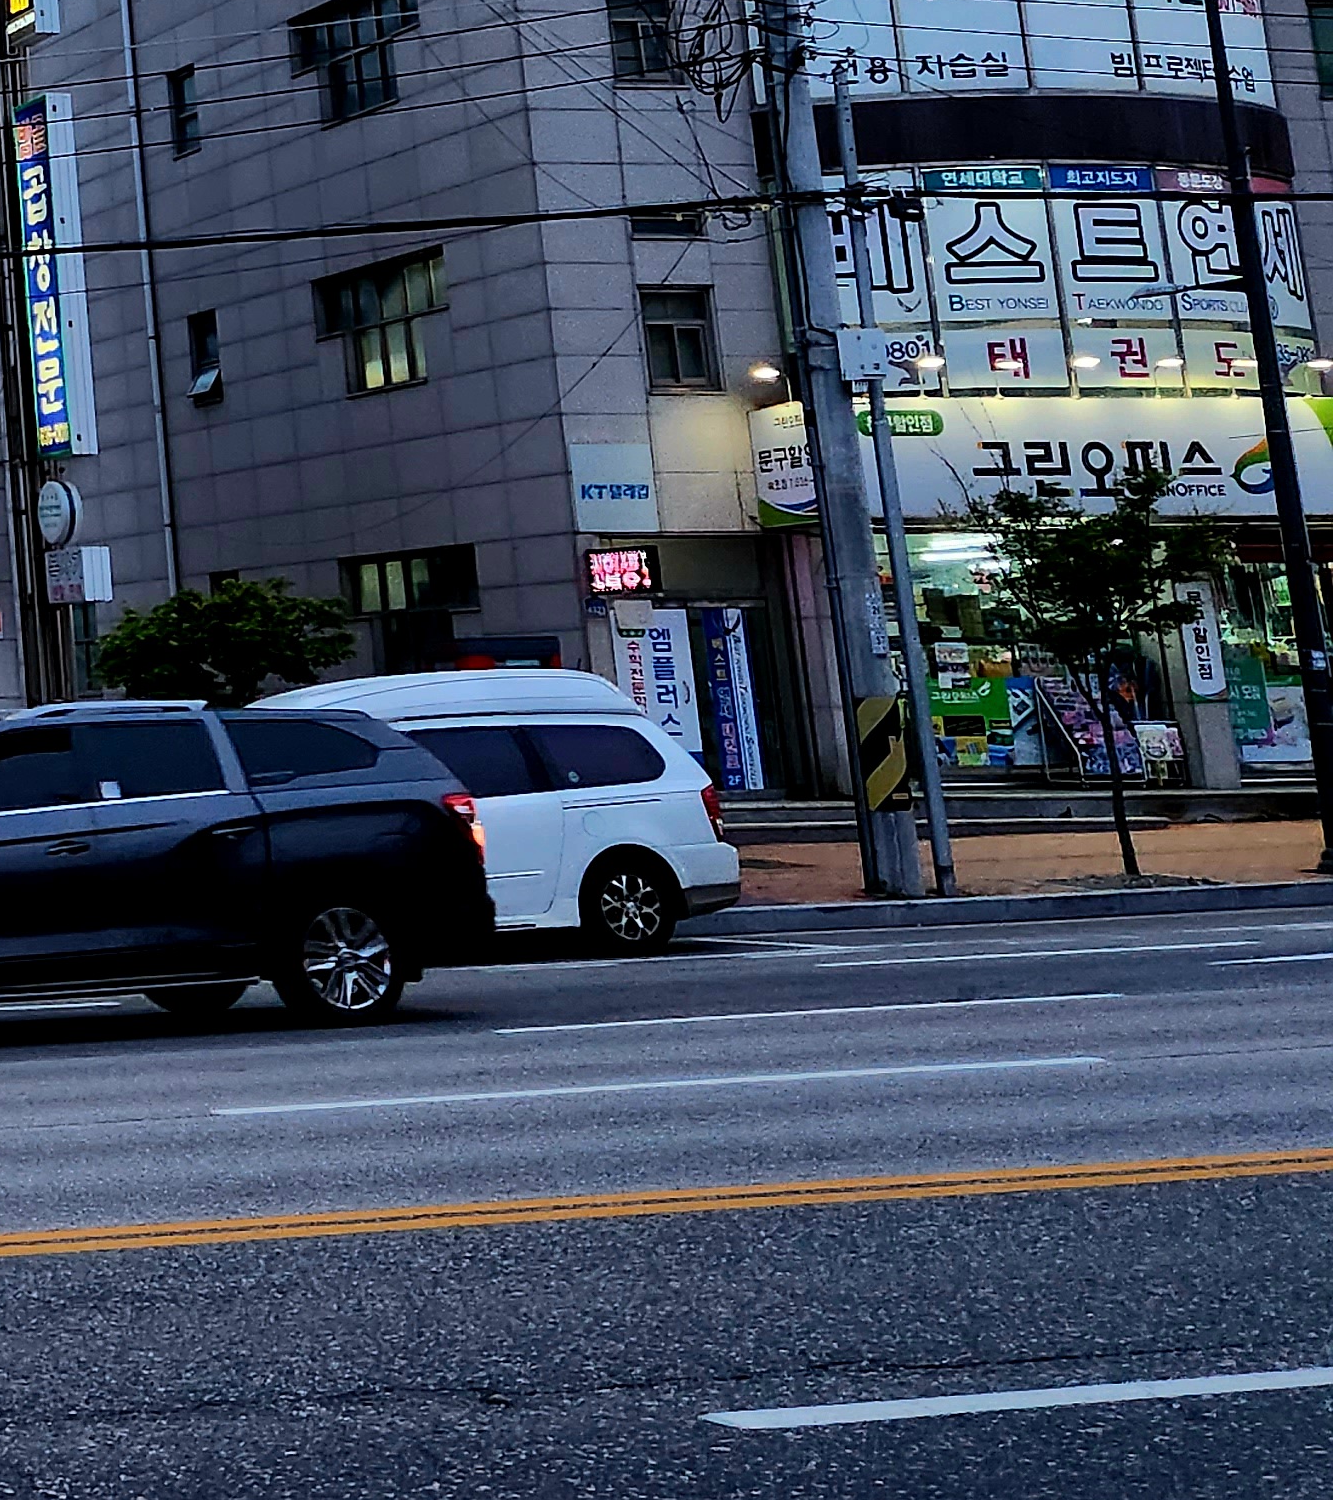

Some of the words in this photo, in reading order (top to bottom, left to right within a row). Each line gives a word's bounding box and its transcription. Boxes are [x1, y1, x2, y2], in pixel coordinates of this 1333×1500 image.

[915, 52, 1009, 80] 자습실
[940, 171, 1025, 187] 연세대학교
[949, 295, 992, 311] BEST
[996, 297, 1049, 311] YONSEI
[973, 441, 1223, 498] 그린오피스
[648, 627, 684, 737] 엠플러스
